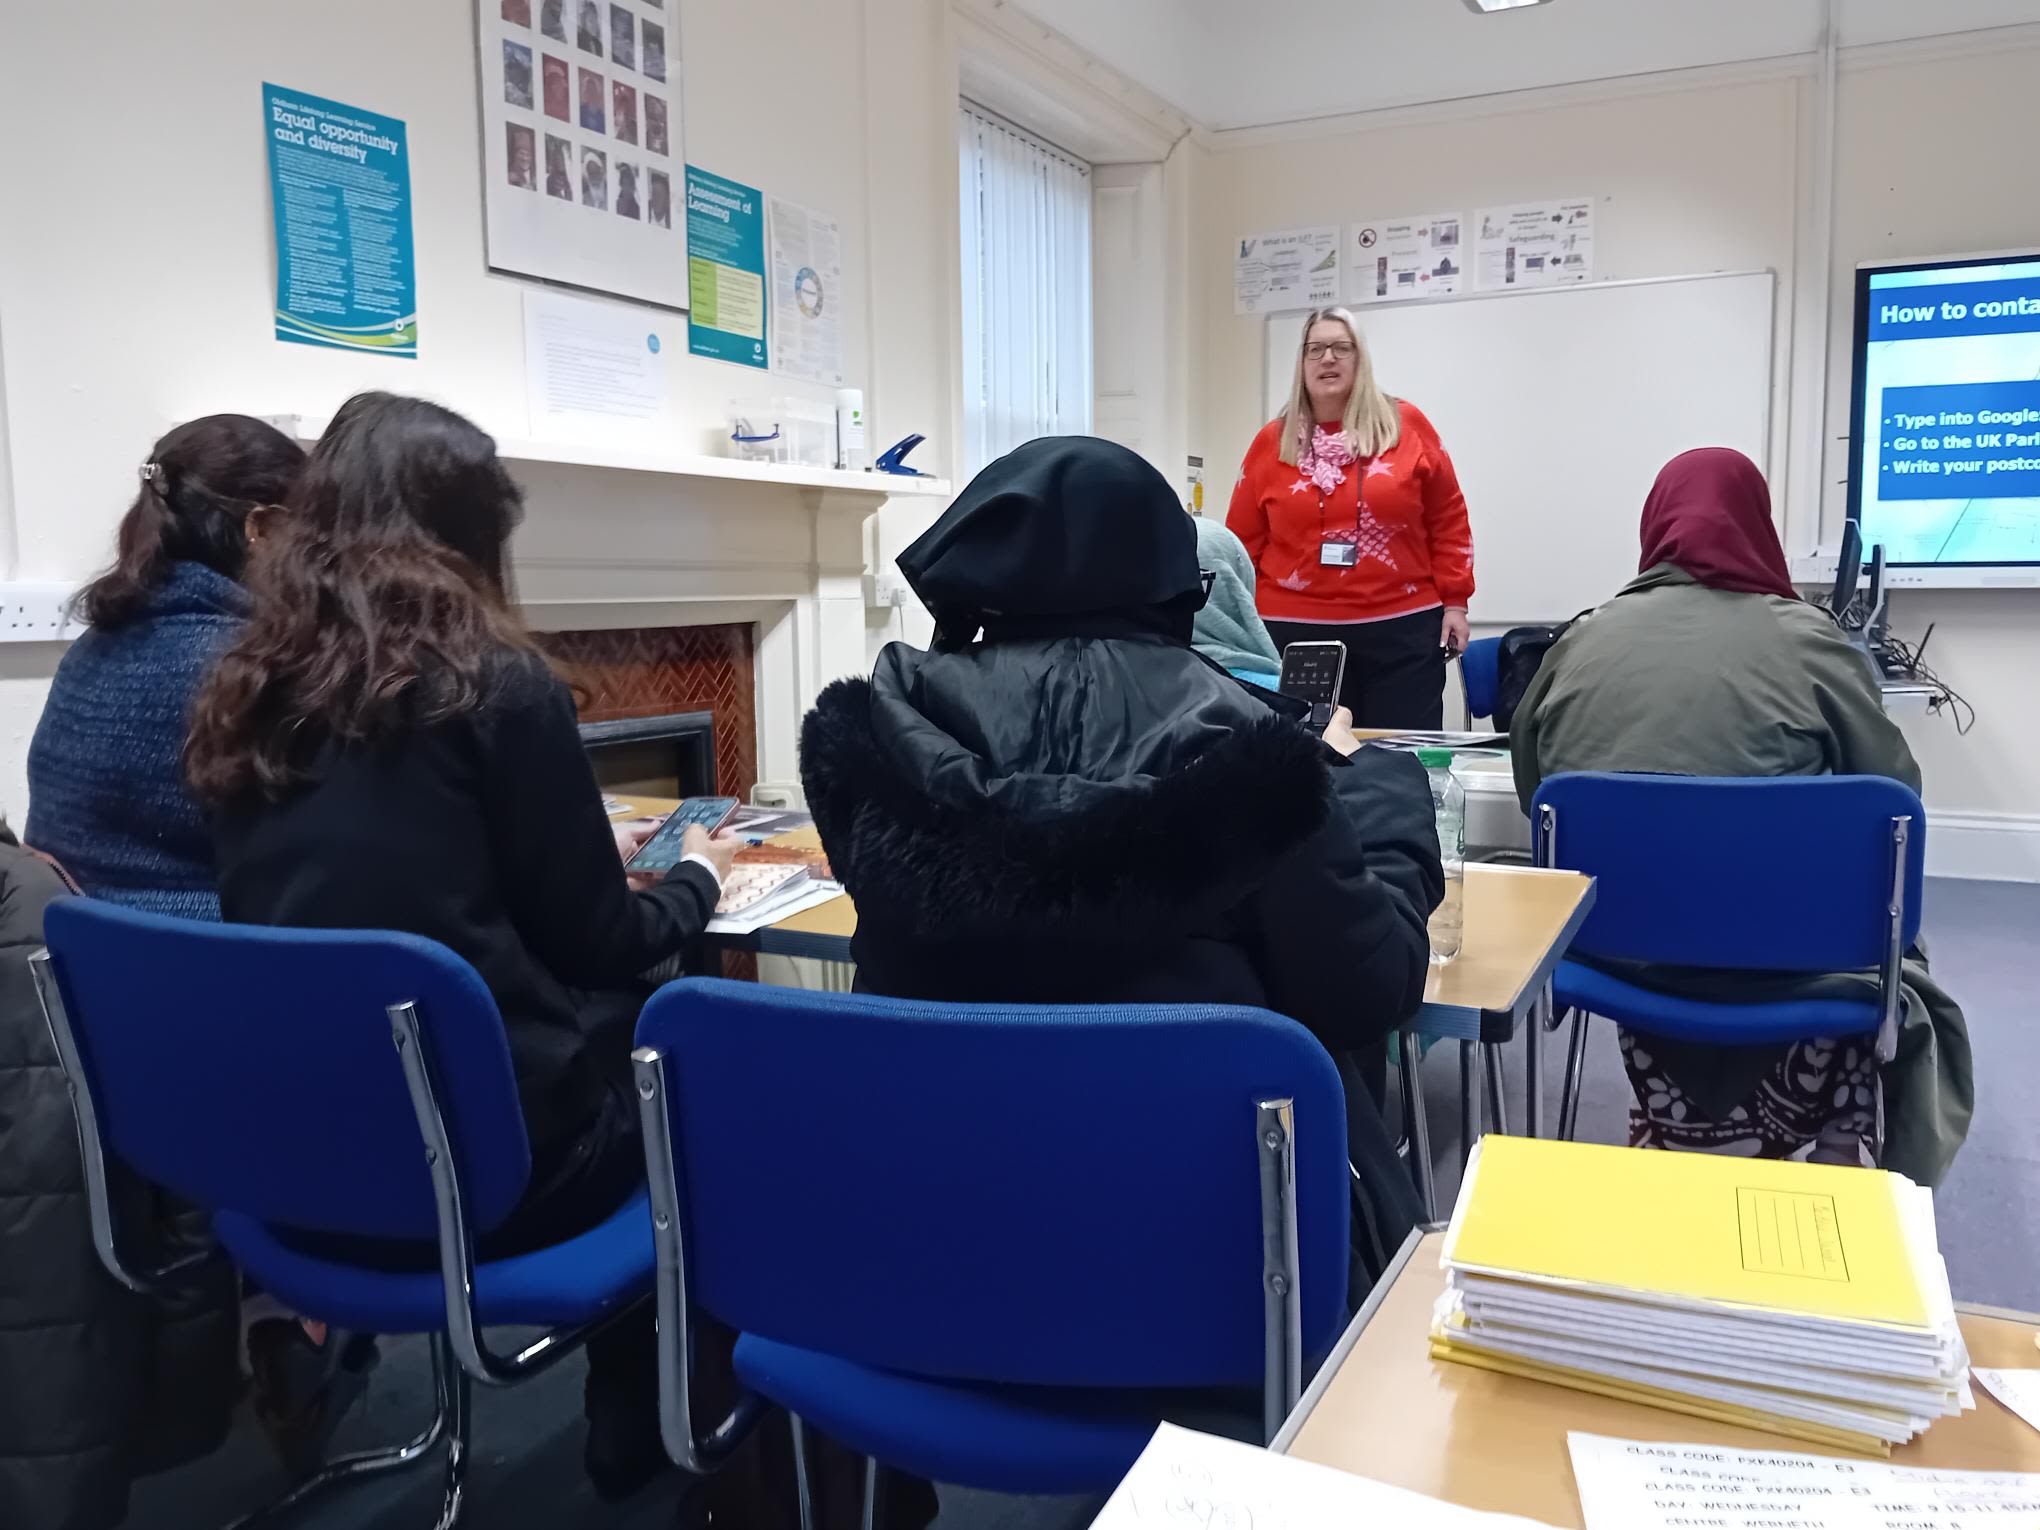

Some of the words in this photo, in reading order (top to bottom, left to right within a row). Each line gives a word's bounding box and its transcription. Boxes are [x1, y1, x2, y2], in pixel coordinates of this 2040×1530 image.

[273, 106, 316, 131] Equal
[319, 122, 398, 155] opportunity
[274, 127, 305, 146] and
[308, 133, 367, 164] diversity
[1881, 305, 1935, 324] How
[1941, 302, 1967, 320] to
[1973, 297, 2040, 318] conta
[1894, 413, 1936, 430] Type
[1939, 412, 1974, 426] into
[1893, 437, 1917, 451] Go
[1921, 437, 1940, 449] to
[1943, 434, 1972, 449] the
[1976, 434, 2002, 448] UK
[1893, 459, 1940, 473] Write
[1943, 460, 1983, 475] your
[1986, 457, 2040, 474] postco
[1627, 1447, 1676, 1458] CLASS
[1683, 1452, 1730, 1462] CODE:
[1738, 1456, 1815, 1469] PXK40204
[1835, 1464, 1855, 1473] E3
[1660, 1466, 1711, 1479] CLASS
[1645, 1482, 1695, 1492] CLASS
[1851, 1487, 1872, 1496] E3
[1700, 1502, 1801, 1512] WEDNESDAY
